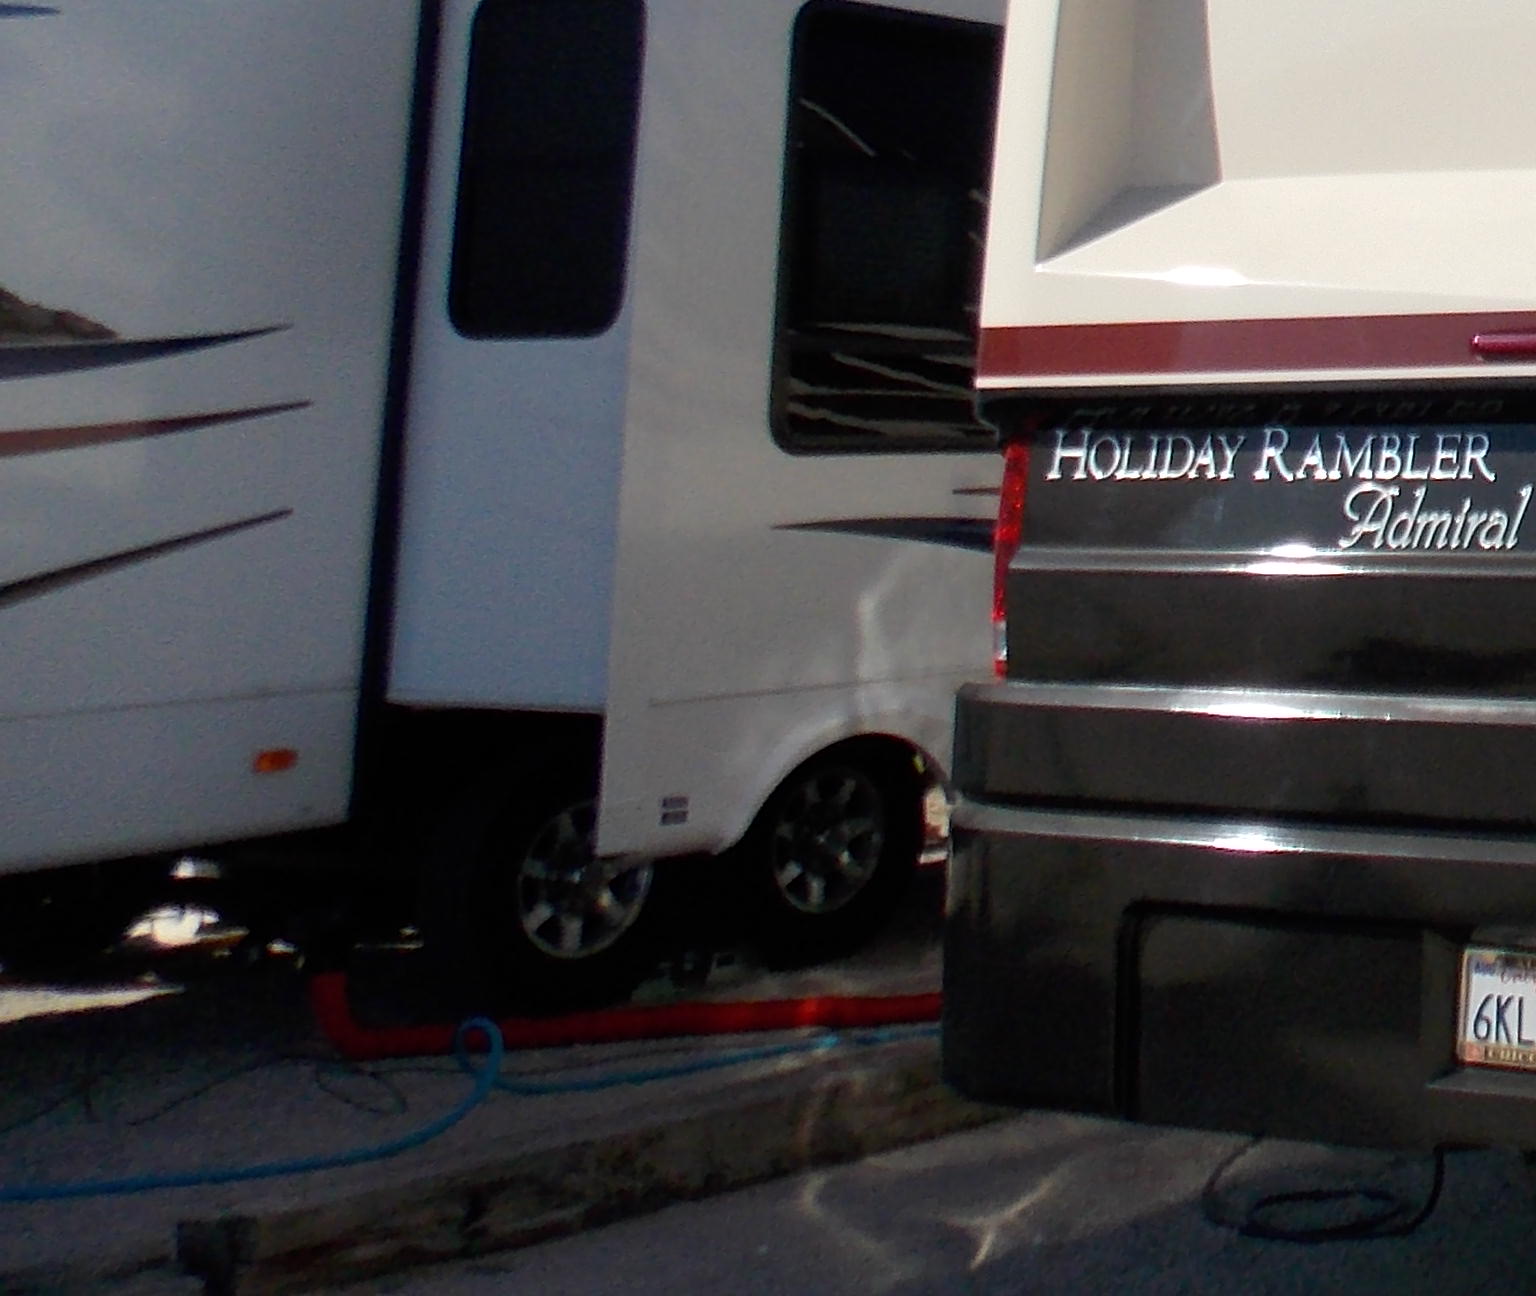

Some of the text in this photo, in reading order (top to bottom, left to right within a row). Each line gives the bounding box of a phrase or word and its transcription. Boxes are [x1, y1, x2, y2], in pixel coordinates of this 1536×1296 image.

[1045, 424, 1496, 482] HOLIDAY RAMBLER
[1338, 481, 1534, 551] Admiral
